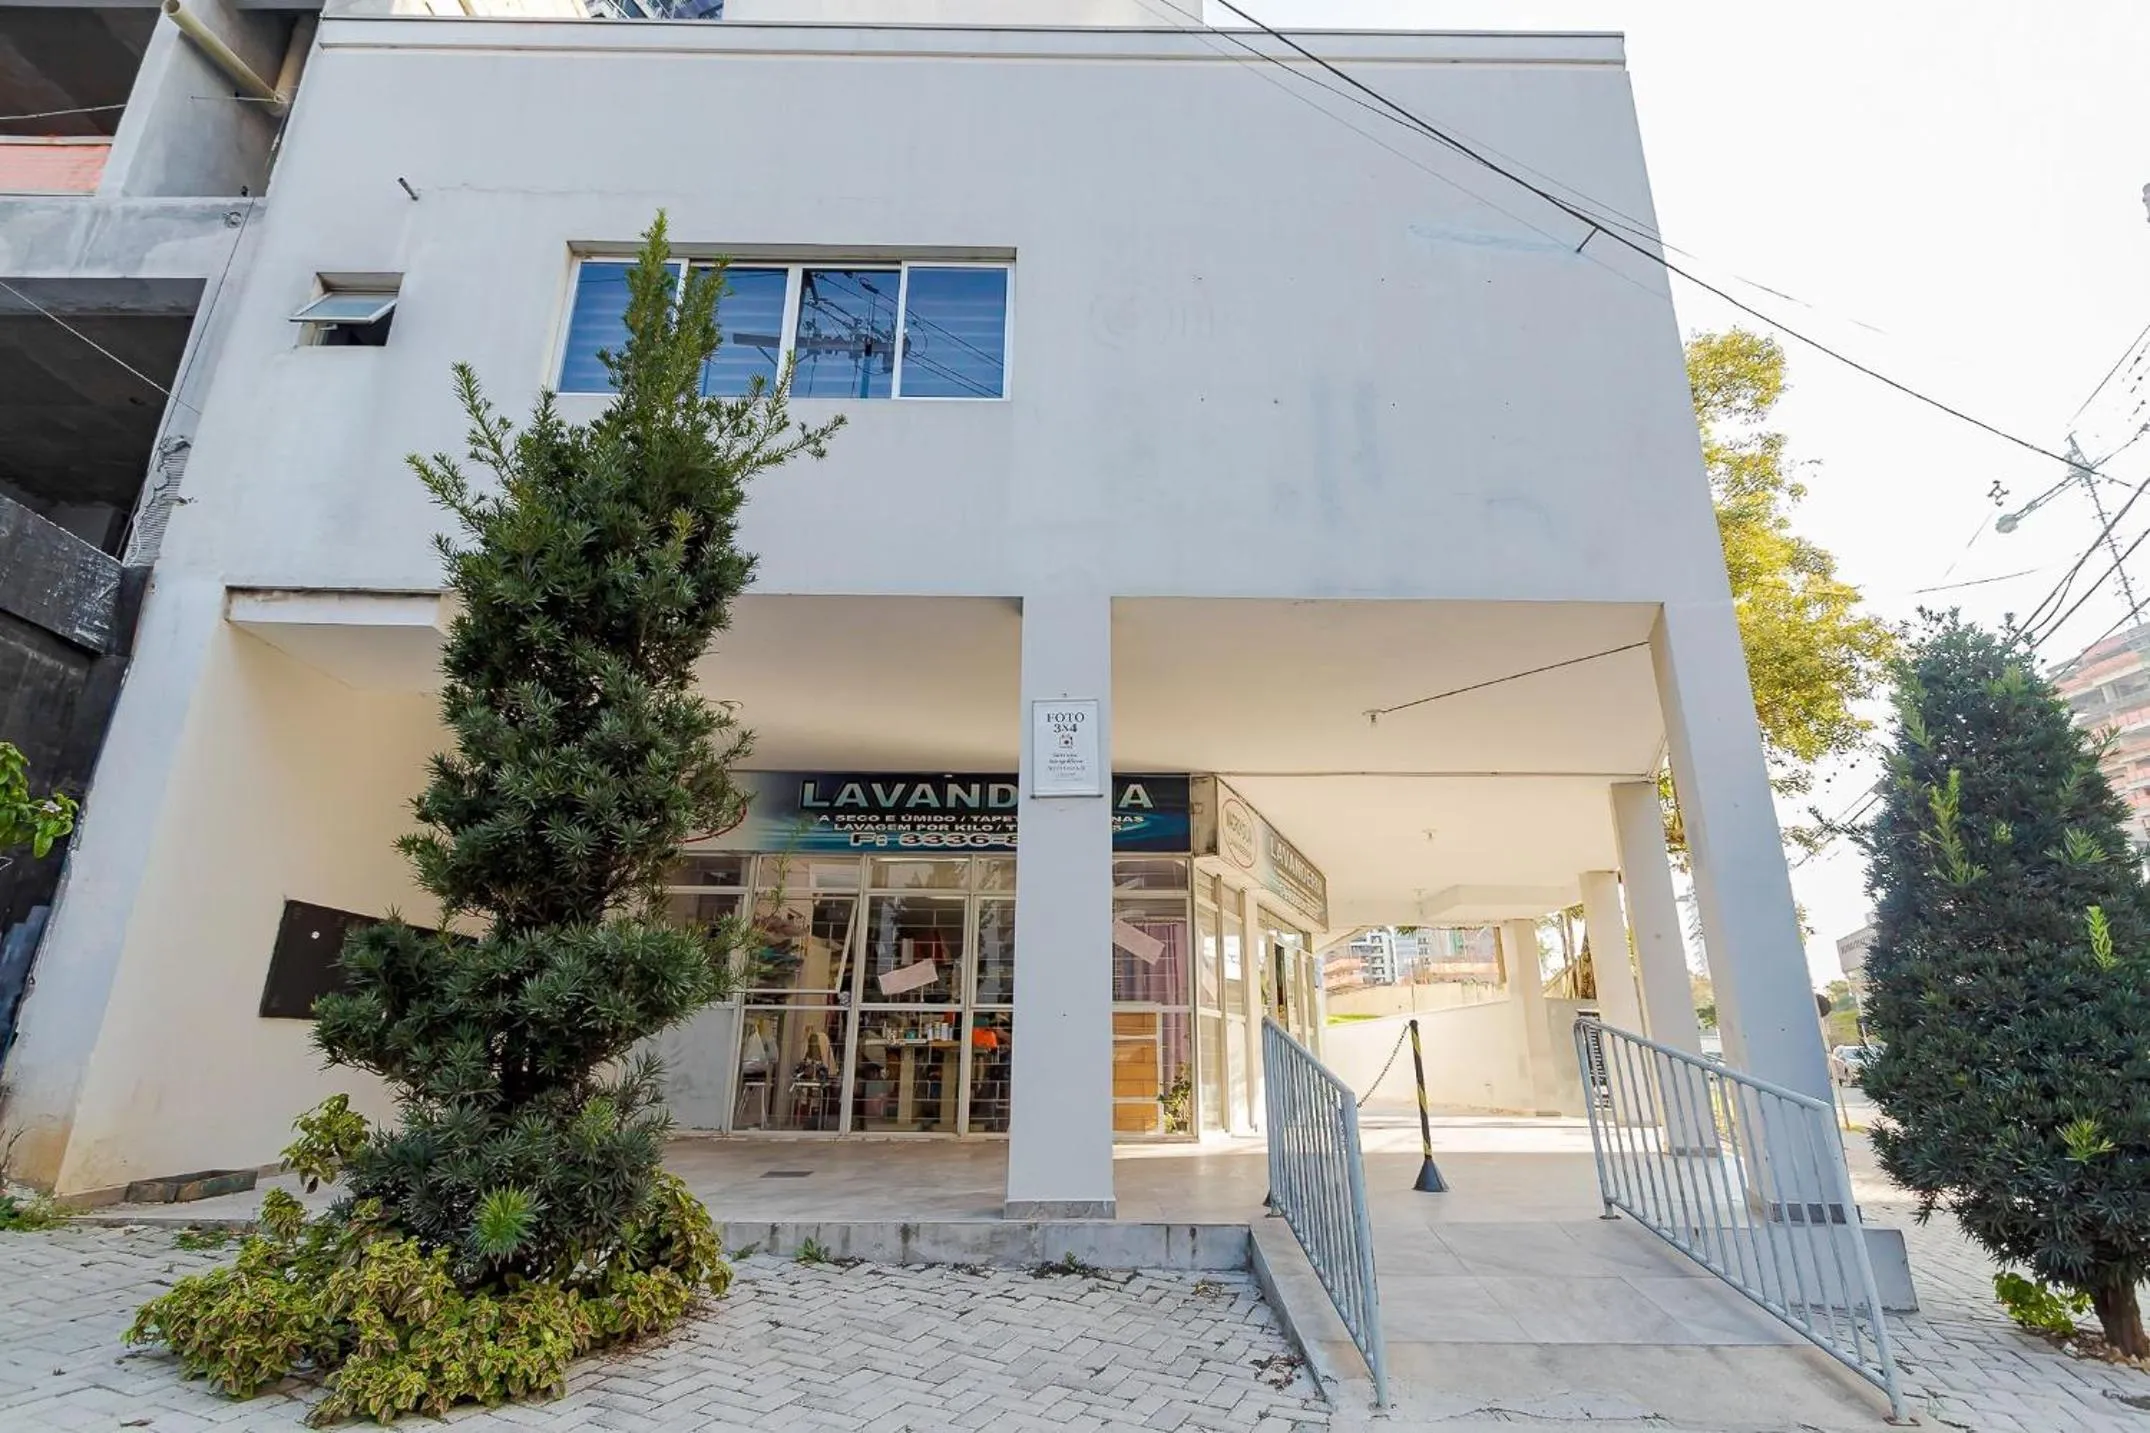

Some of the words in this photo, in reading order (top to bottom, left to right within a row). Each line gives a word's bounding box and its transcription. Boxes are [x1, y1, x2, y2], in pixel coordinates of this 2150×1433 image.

[1046, 711, 1085, 723] FOTO
[802, 782, 1154, 808] LAVANDA
[818, 814, 830, 823] A
[835, 814, 880, 823] SECO
[885, 814, 896, 823] E
[901, 813, 956, 823] ÚMIDO
[833, 823, 911, 831] LAVAGEM
[916, 823, 949, 831] POR
